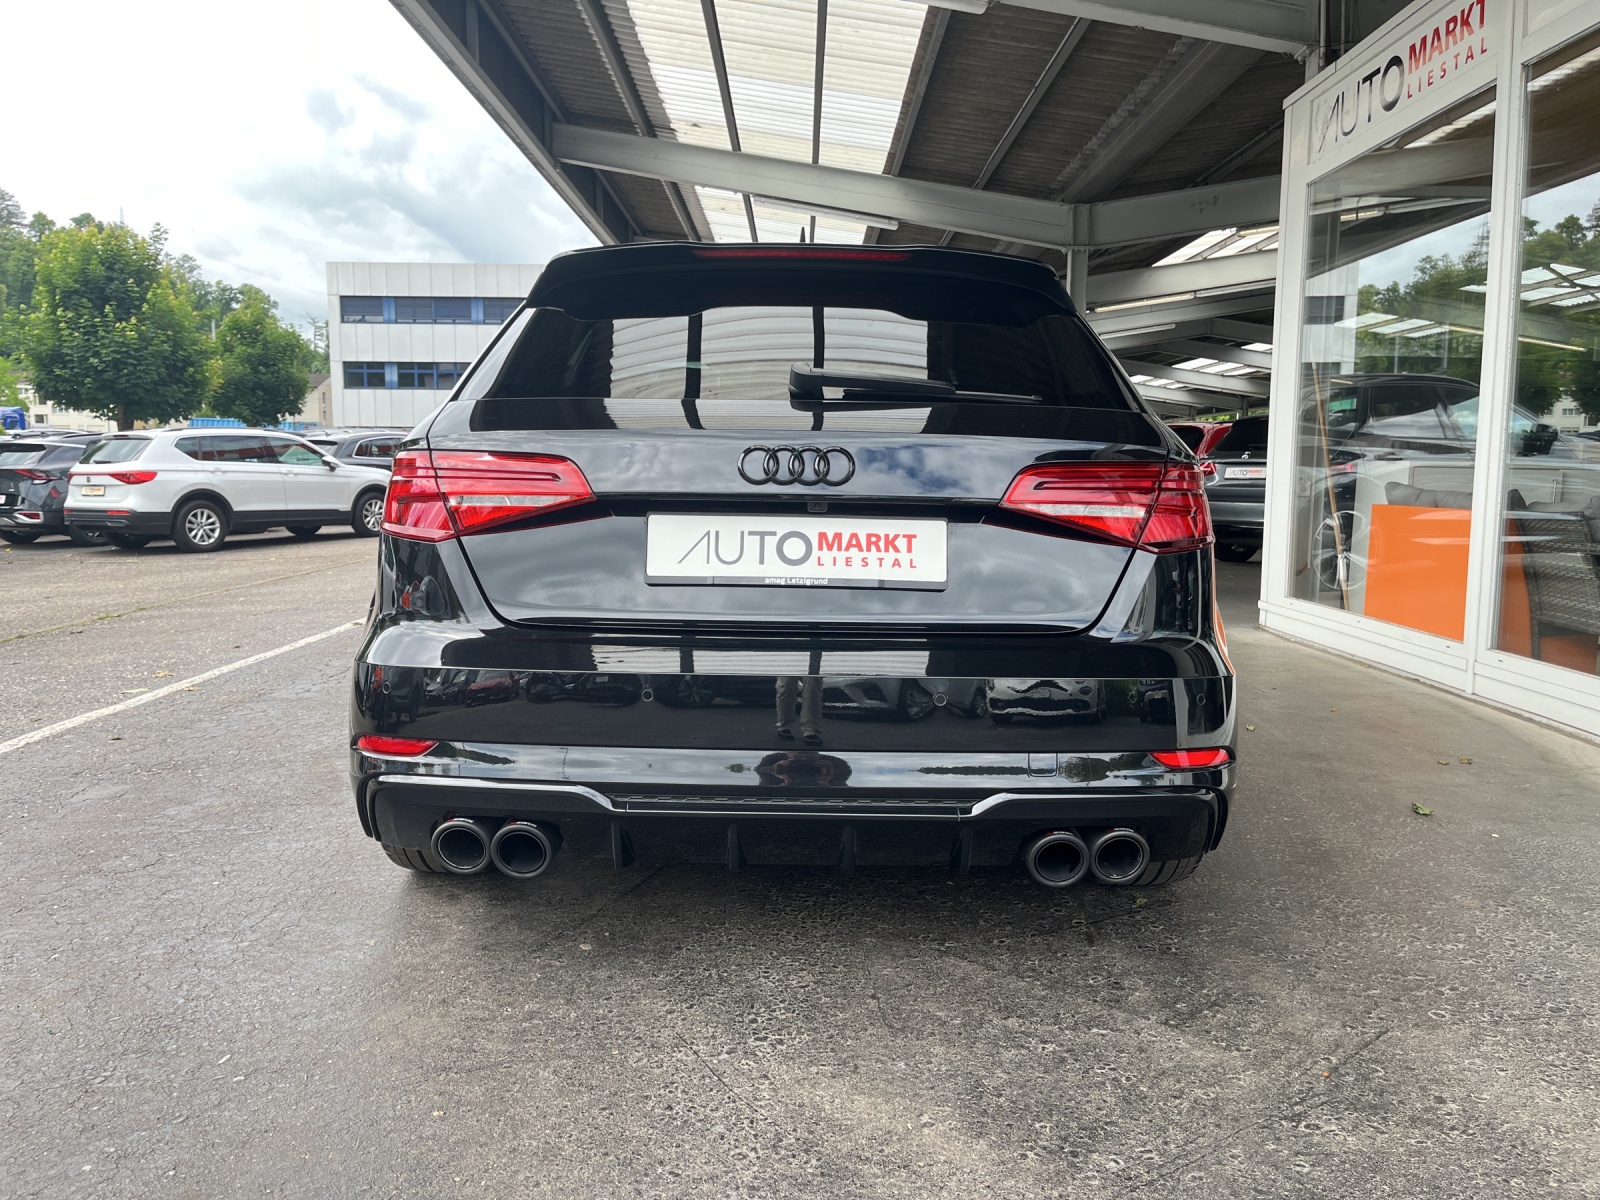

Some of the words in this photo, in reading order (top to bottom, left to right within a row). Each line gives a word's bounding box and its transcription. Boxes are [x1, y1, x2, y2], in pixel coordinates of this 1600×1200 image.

[1318, 55, 1404, 153] AUTO
[1407, 0, 1487, 75] MARKT
[1407, 37, 1488, 100] LIESTAL
[677, 530, 813, 567] AUTO
[817, 531, 918, 554] MARKT
[817, 555, 918, 569] LIESTAL
[764, 577, 786, 586] amag
